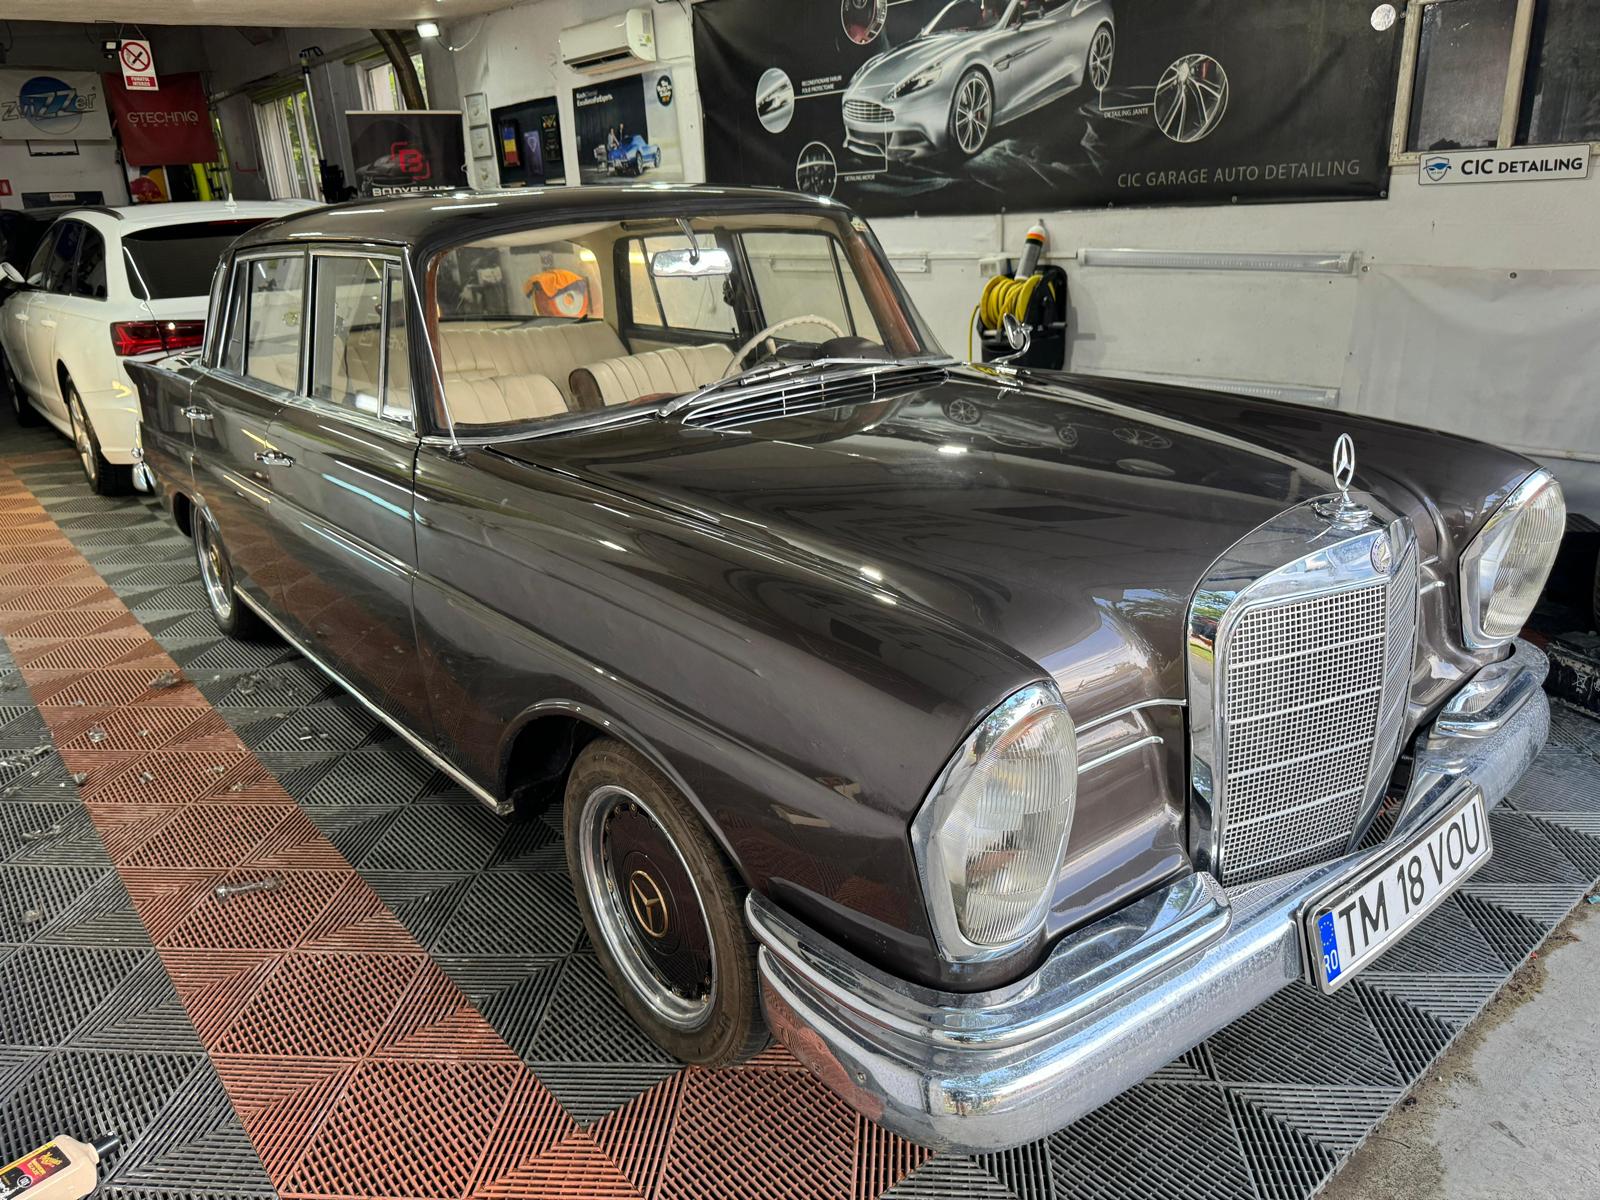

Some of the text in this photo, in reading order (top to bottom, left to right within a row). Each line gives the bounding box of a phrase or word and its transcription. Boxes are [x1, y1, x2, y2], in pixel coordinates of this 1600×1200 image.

[1117, 159, 1361, 188] CIC GARAGE AUTO DETAILING
[1461, 157, 1583, 175] CIC DETAILING
[1338, 803, 1480, 958] TM 18 VOU
